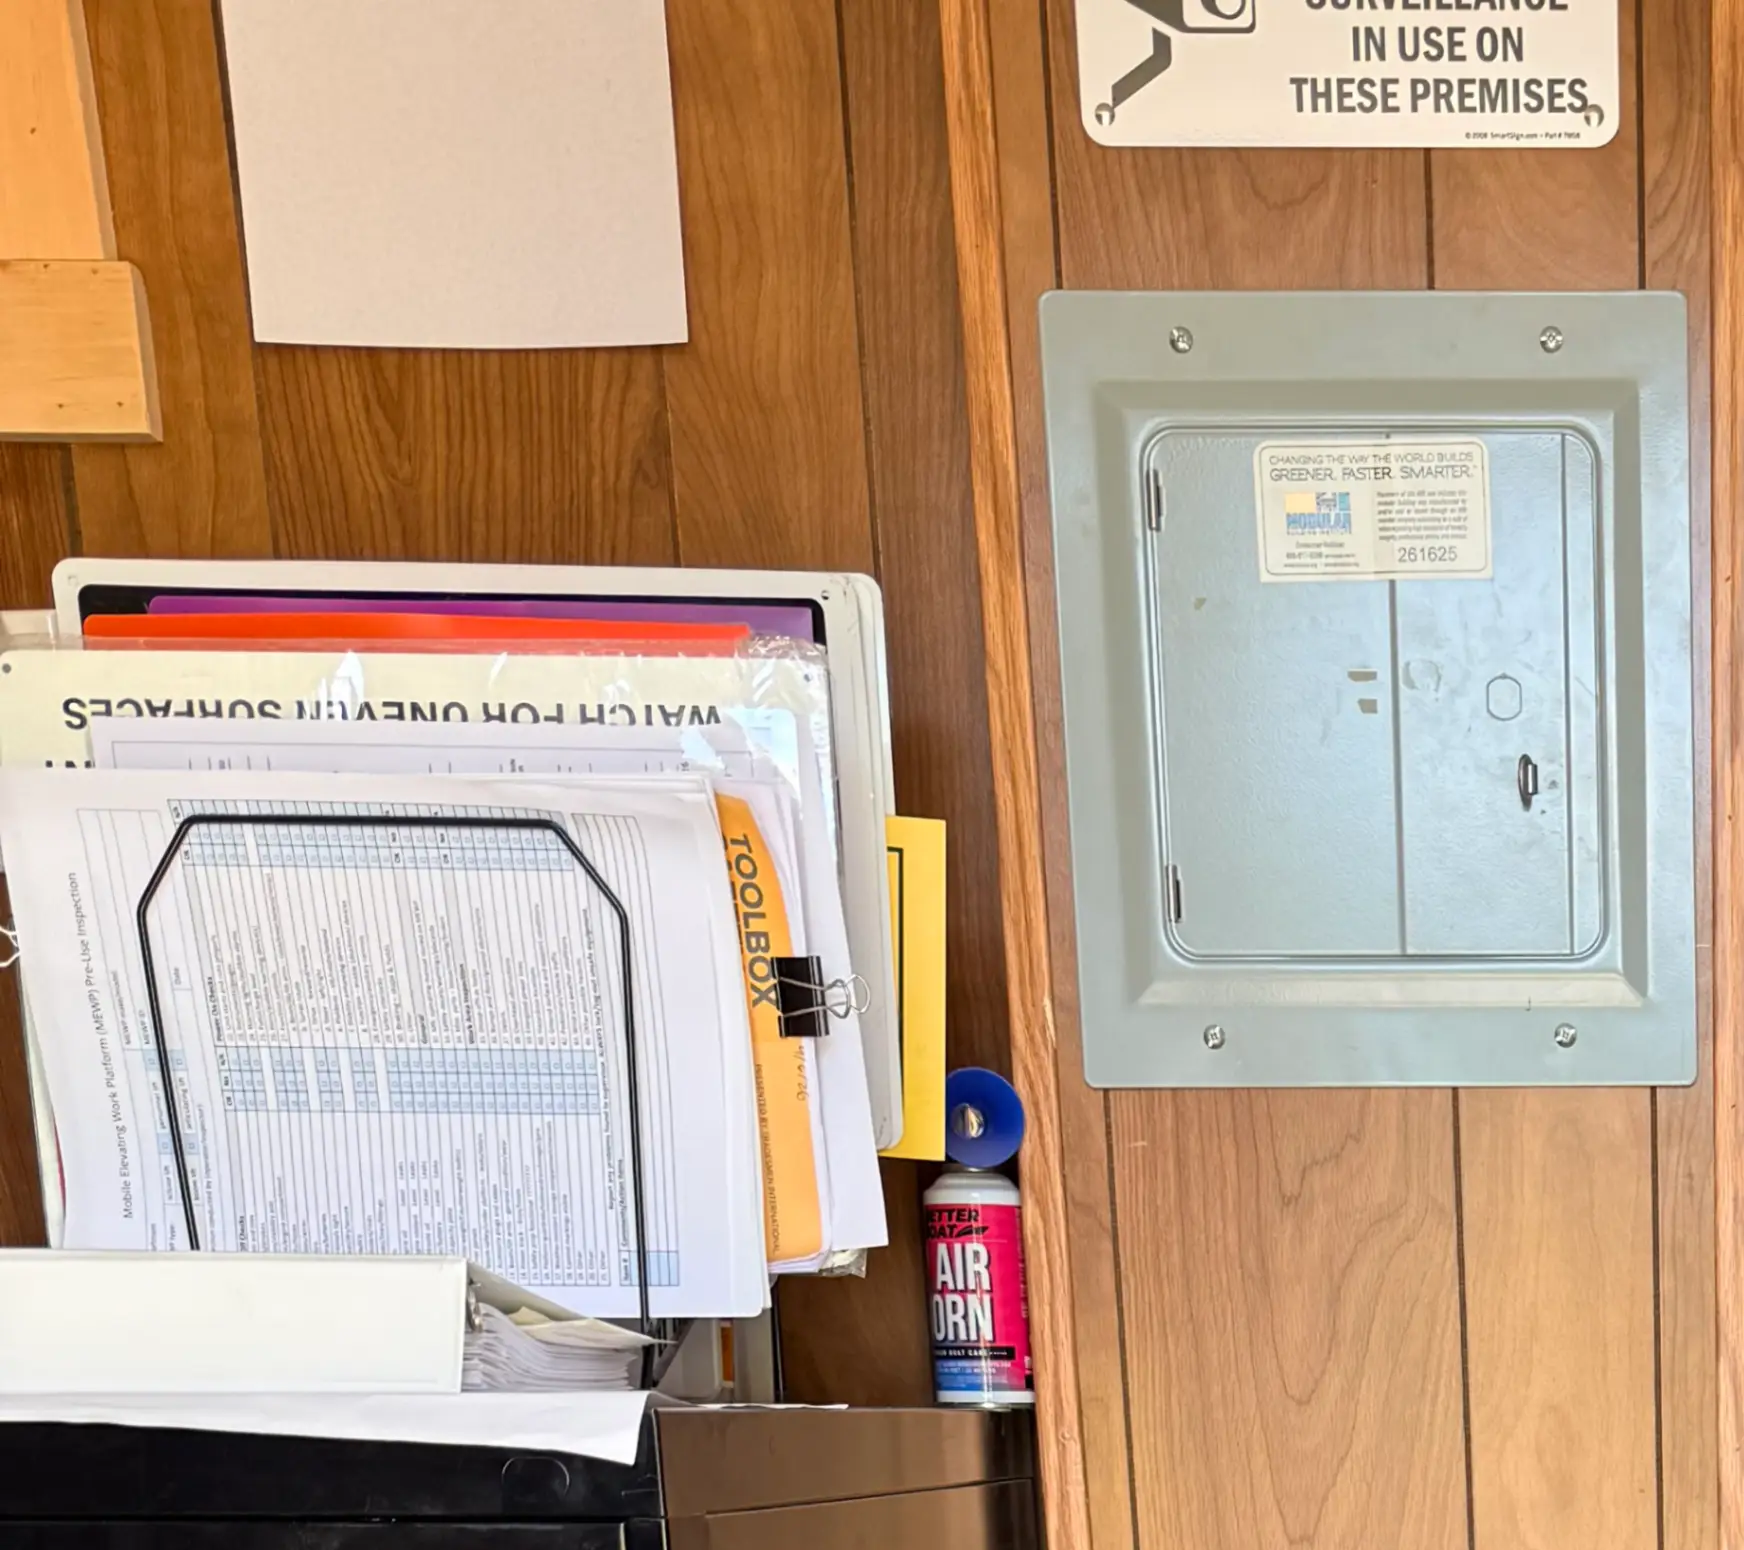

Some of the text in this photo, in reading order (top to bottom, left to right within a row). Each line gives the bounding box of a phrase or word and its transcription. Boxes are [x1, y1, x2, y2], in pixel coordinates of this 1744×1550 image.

[1352, 27, 1524, 62] IN USE ON
[1290, 78, 1589, 114] THESE PREMISES
[1269, 452, 1474, 466] CHANGING THE WAY THE WORLD BUILDS
[1398, 547, 1458, 563] 261625
[67, 872, 87, 935] Inspection
[730, 833, 777, 1008] TOOLBOX
[97, 1038, 115, 1088] Platform
[109, 1091, 122, 1122] Work
[114, 1125, 129, 1177] Elevating
[122, 1181, 133, 1218] Mobile
[928, 1208, 980, 1224] ETTER
[936, 1242, 992, 1292] AIR
[932, 1293, 994, 1342] ORN
